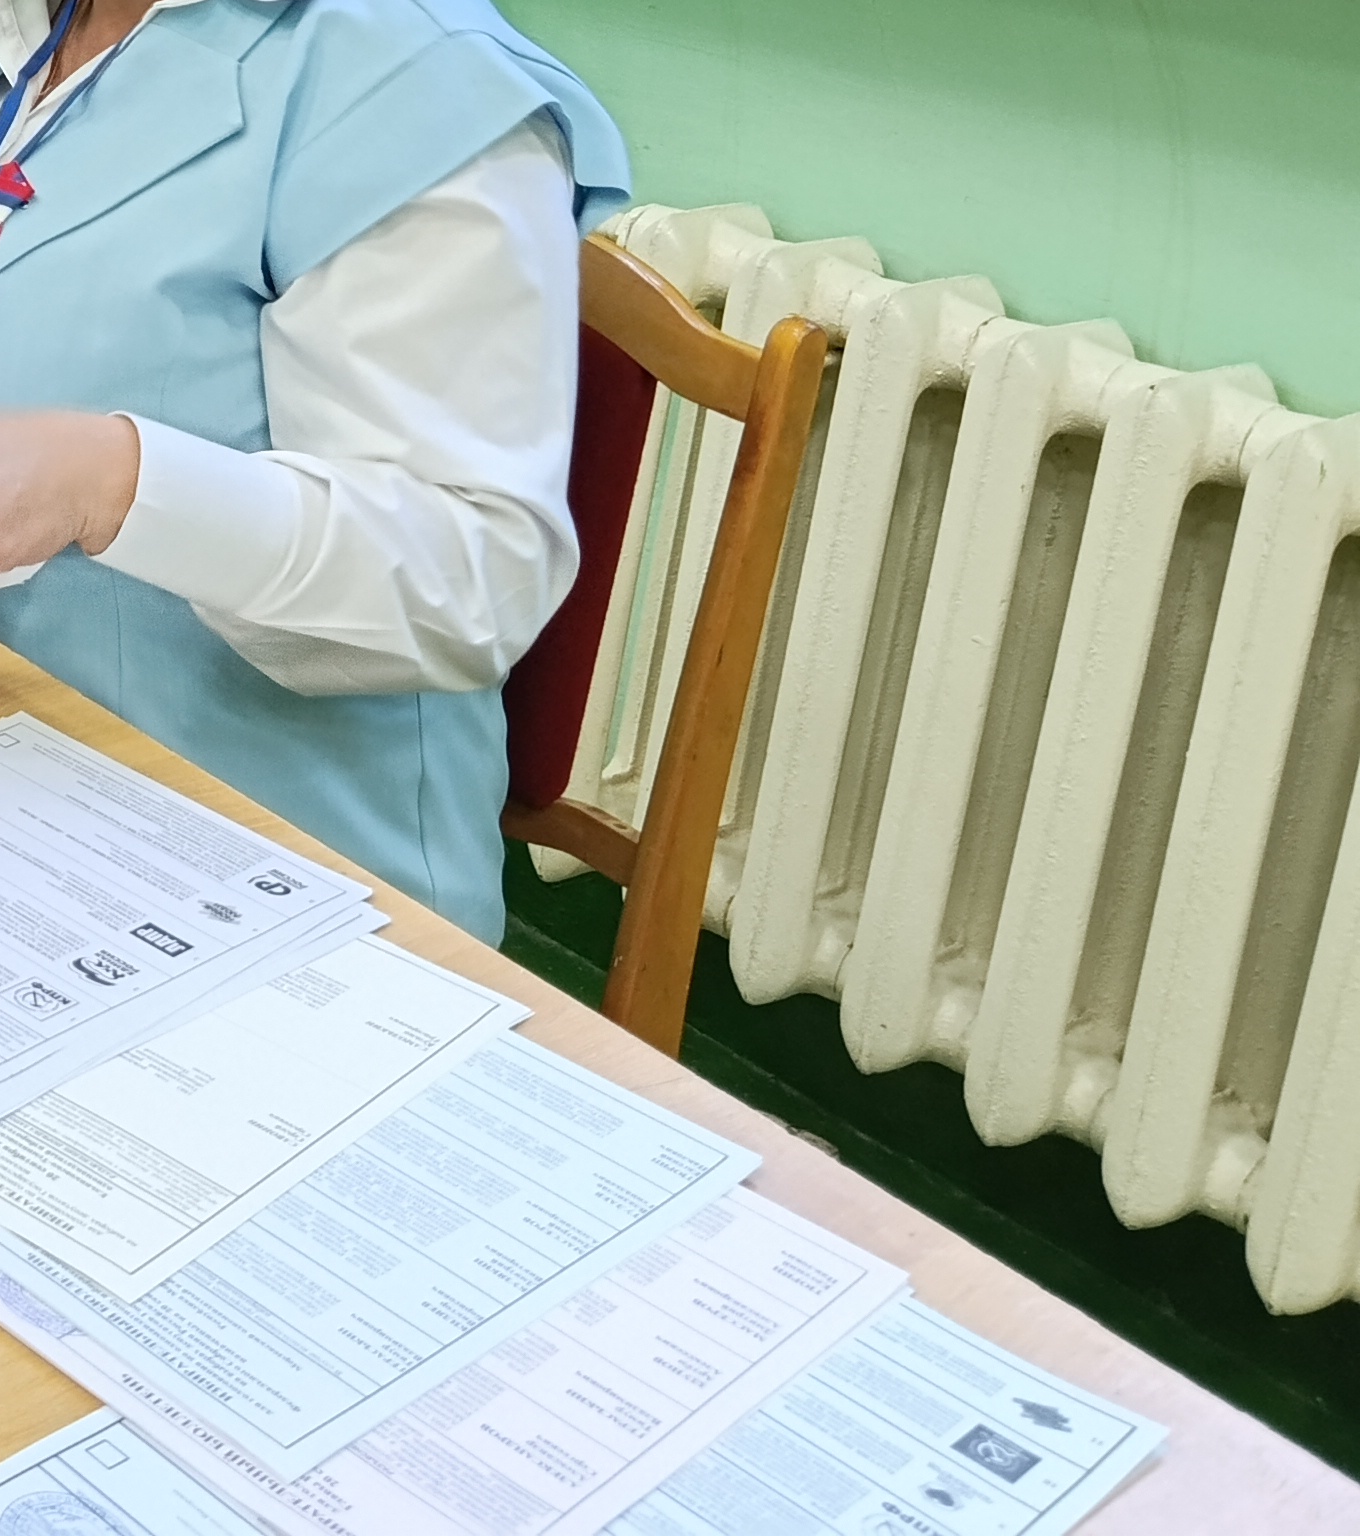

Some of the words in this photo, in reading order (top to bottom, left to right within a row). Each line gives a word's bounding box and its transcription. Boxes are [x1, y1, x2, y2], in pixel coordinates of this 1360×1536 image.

[98, 948, 141, 973] РОССИЯ
[133, 924, 188, 954] ЛДПР
[92, 951, 135, 975] ЕДИНАЯ
[28, 980, 72, 1005] КПРФ
[22, 1250, 112, 1313] БЮЛЛЕТЕНЬ
[105, 1311, 235, 1403] ИЗБИРАТЕЛЬНЫЙ
[118, 1372, 227, 1462] БЮЛЛЕТЕНЬ
[477, 1421, 581, 1489] АЛЕКСАНДРОВ
